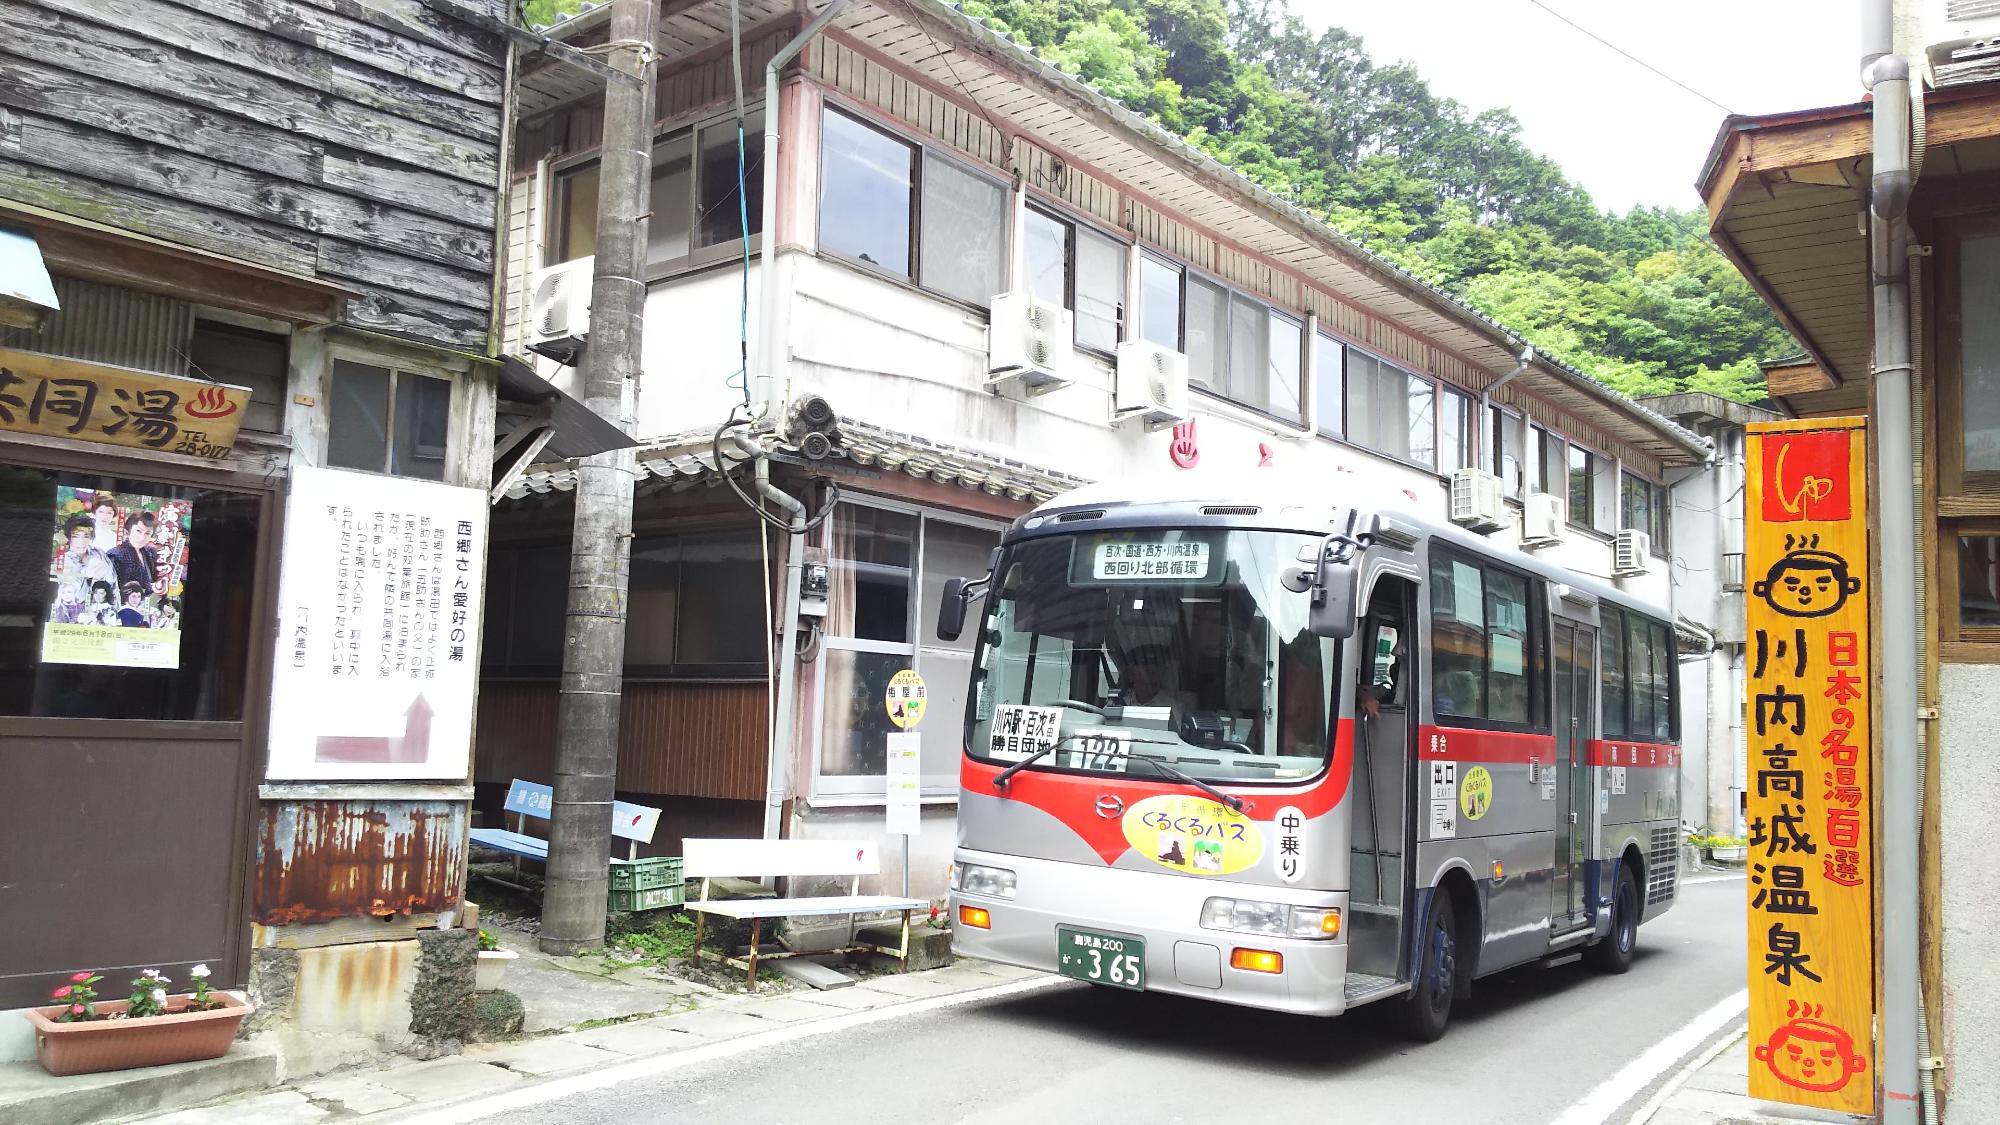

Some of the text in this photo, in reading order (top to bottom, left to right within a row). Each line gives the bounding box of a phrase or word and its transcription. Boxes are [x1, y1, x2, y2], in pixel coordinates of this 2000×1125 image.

[182, 429, 208, 443] TEL
[174, 442, 232, 458] 28-0177
[1106, 543, 1200, 558] 百次・国道・西方・川内温泉
[1104, 560, 1199, 575] 西回り北部循環
[448, 520, 473, 662] 西郷さん愛好の湯
[992, 708, 1048, 738] 川内駅・百次
[991, 734, 1051, 755] 勝目団地
[1079, 738, 1120, 770] 122
[1819, 630, 1863, 887] 日本の名湯百選
[1434, 764, 1454, 785] 出口
[1436, 788, 1451, 797] EXIT
[1750, 629, 1822, 987] 川内高城温泉
[1142, 811, 1245, 842] くるくるバス
[1280, 813, 1301, 877] 中乗り
